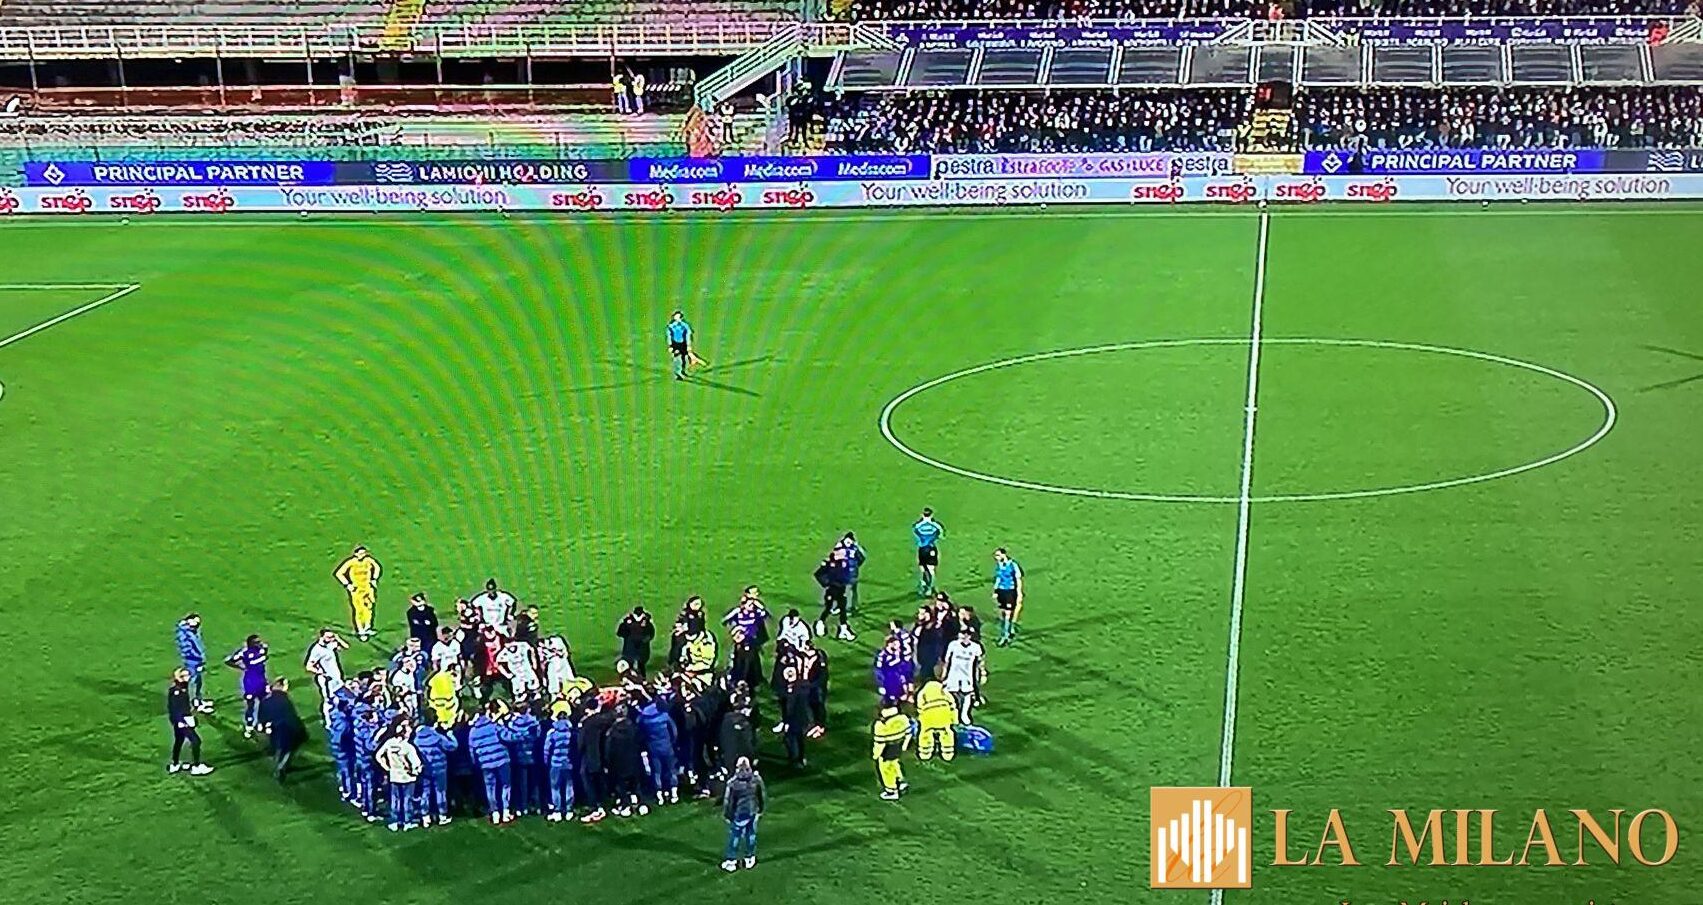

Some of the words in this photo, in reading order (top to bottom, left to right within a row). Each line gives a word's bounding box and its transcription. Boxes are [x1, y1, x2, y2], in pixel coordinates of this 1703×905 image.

[1371, 153, 1476, 169] PRINCIPAL
[1481, 153, 1577, 169] PARTNER
[92, 165, 203, 181] PRINCIPAL
[206, 164, 304, 180] PARTNER
[860, 182, 907, 200] Your
[1012, 181, 1088, 198] solution
[1446, 177, 1493, 195] Your
[1594, 176, 1671, 194] solution
[281, 188, 328, 206] Your
[431, 185, 508, 204] solution
